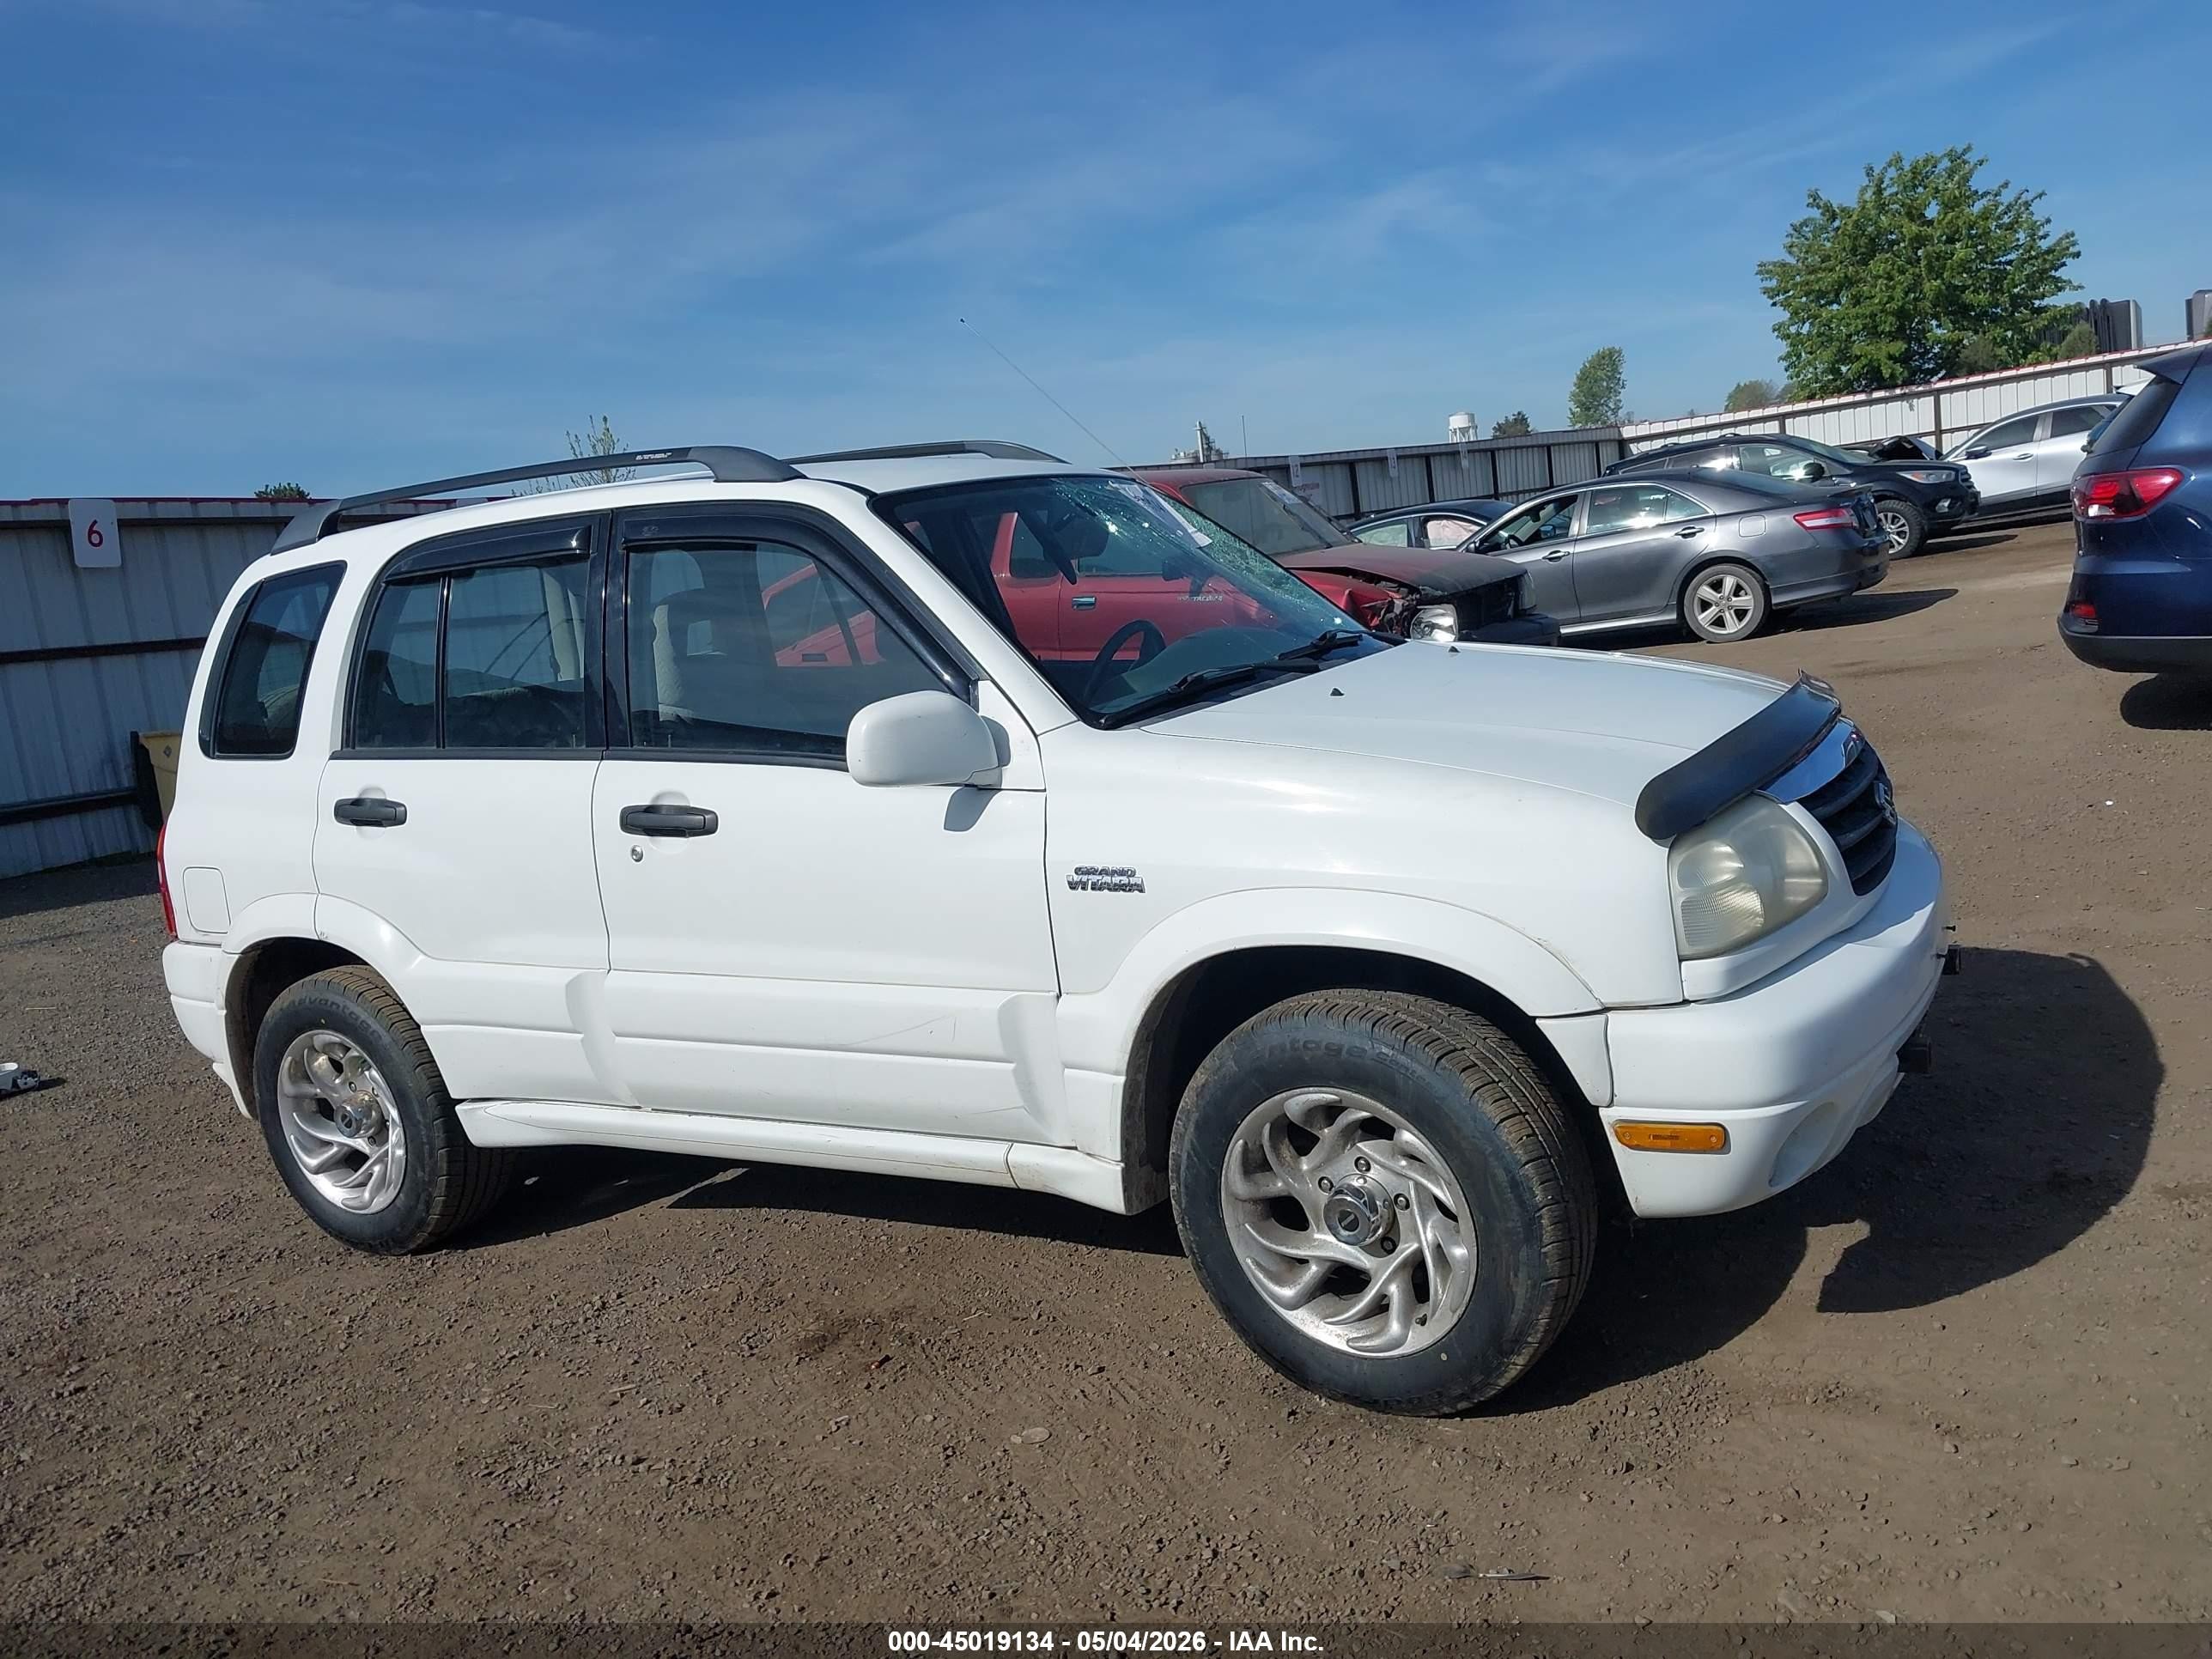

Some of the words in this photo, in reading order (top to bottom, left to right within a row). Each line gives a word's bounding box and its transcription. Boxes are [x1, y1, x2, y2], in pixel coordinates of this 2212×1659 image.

[88, 519, 104, 548] 6
[1073, 866, 1137, 878] GRAND
[1066, 874, 1146, 894] VITARA
